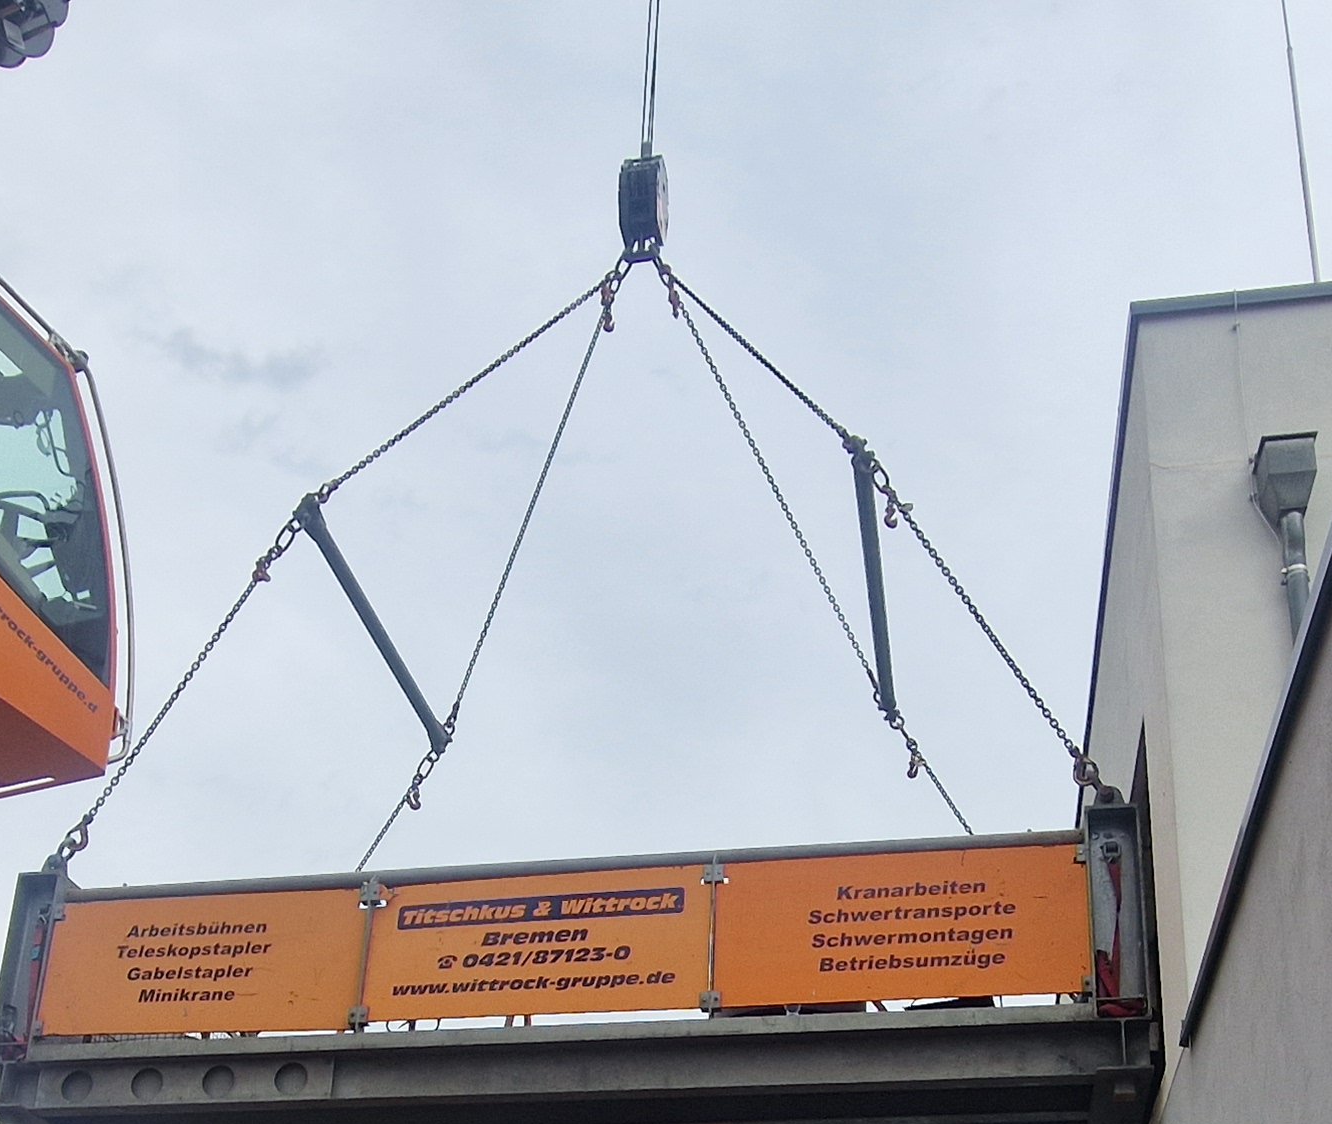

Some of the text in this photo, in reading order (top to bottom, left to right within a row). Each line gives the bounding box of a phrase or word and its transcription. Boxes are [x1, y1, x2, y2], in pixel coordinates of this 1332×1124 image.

[836, 880, 987, 900] Kranarbeiten
[402, 893, 679, 926] Titschkus & Wittrock
[808, 901, 1017, 925] Schwertransporte
[127, 921, 268, 938] Arbeitsbühnen
[481, 928, 589, 947] Bremen
[811, 927, 1014, 949] Schwermontagen
[117, 941, 272, 960] Teleskopstapler
[462, 945, 632, 969] 0421/87123-0
[819, 949, 1006, 972] Betriebsumzüge
[127, 964, 254, 982] Gabelstapler
[392, 970, 676, 997] www.wittrock-gruppe.de
[138, 987, 236, 1003] Minikrane
